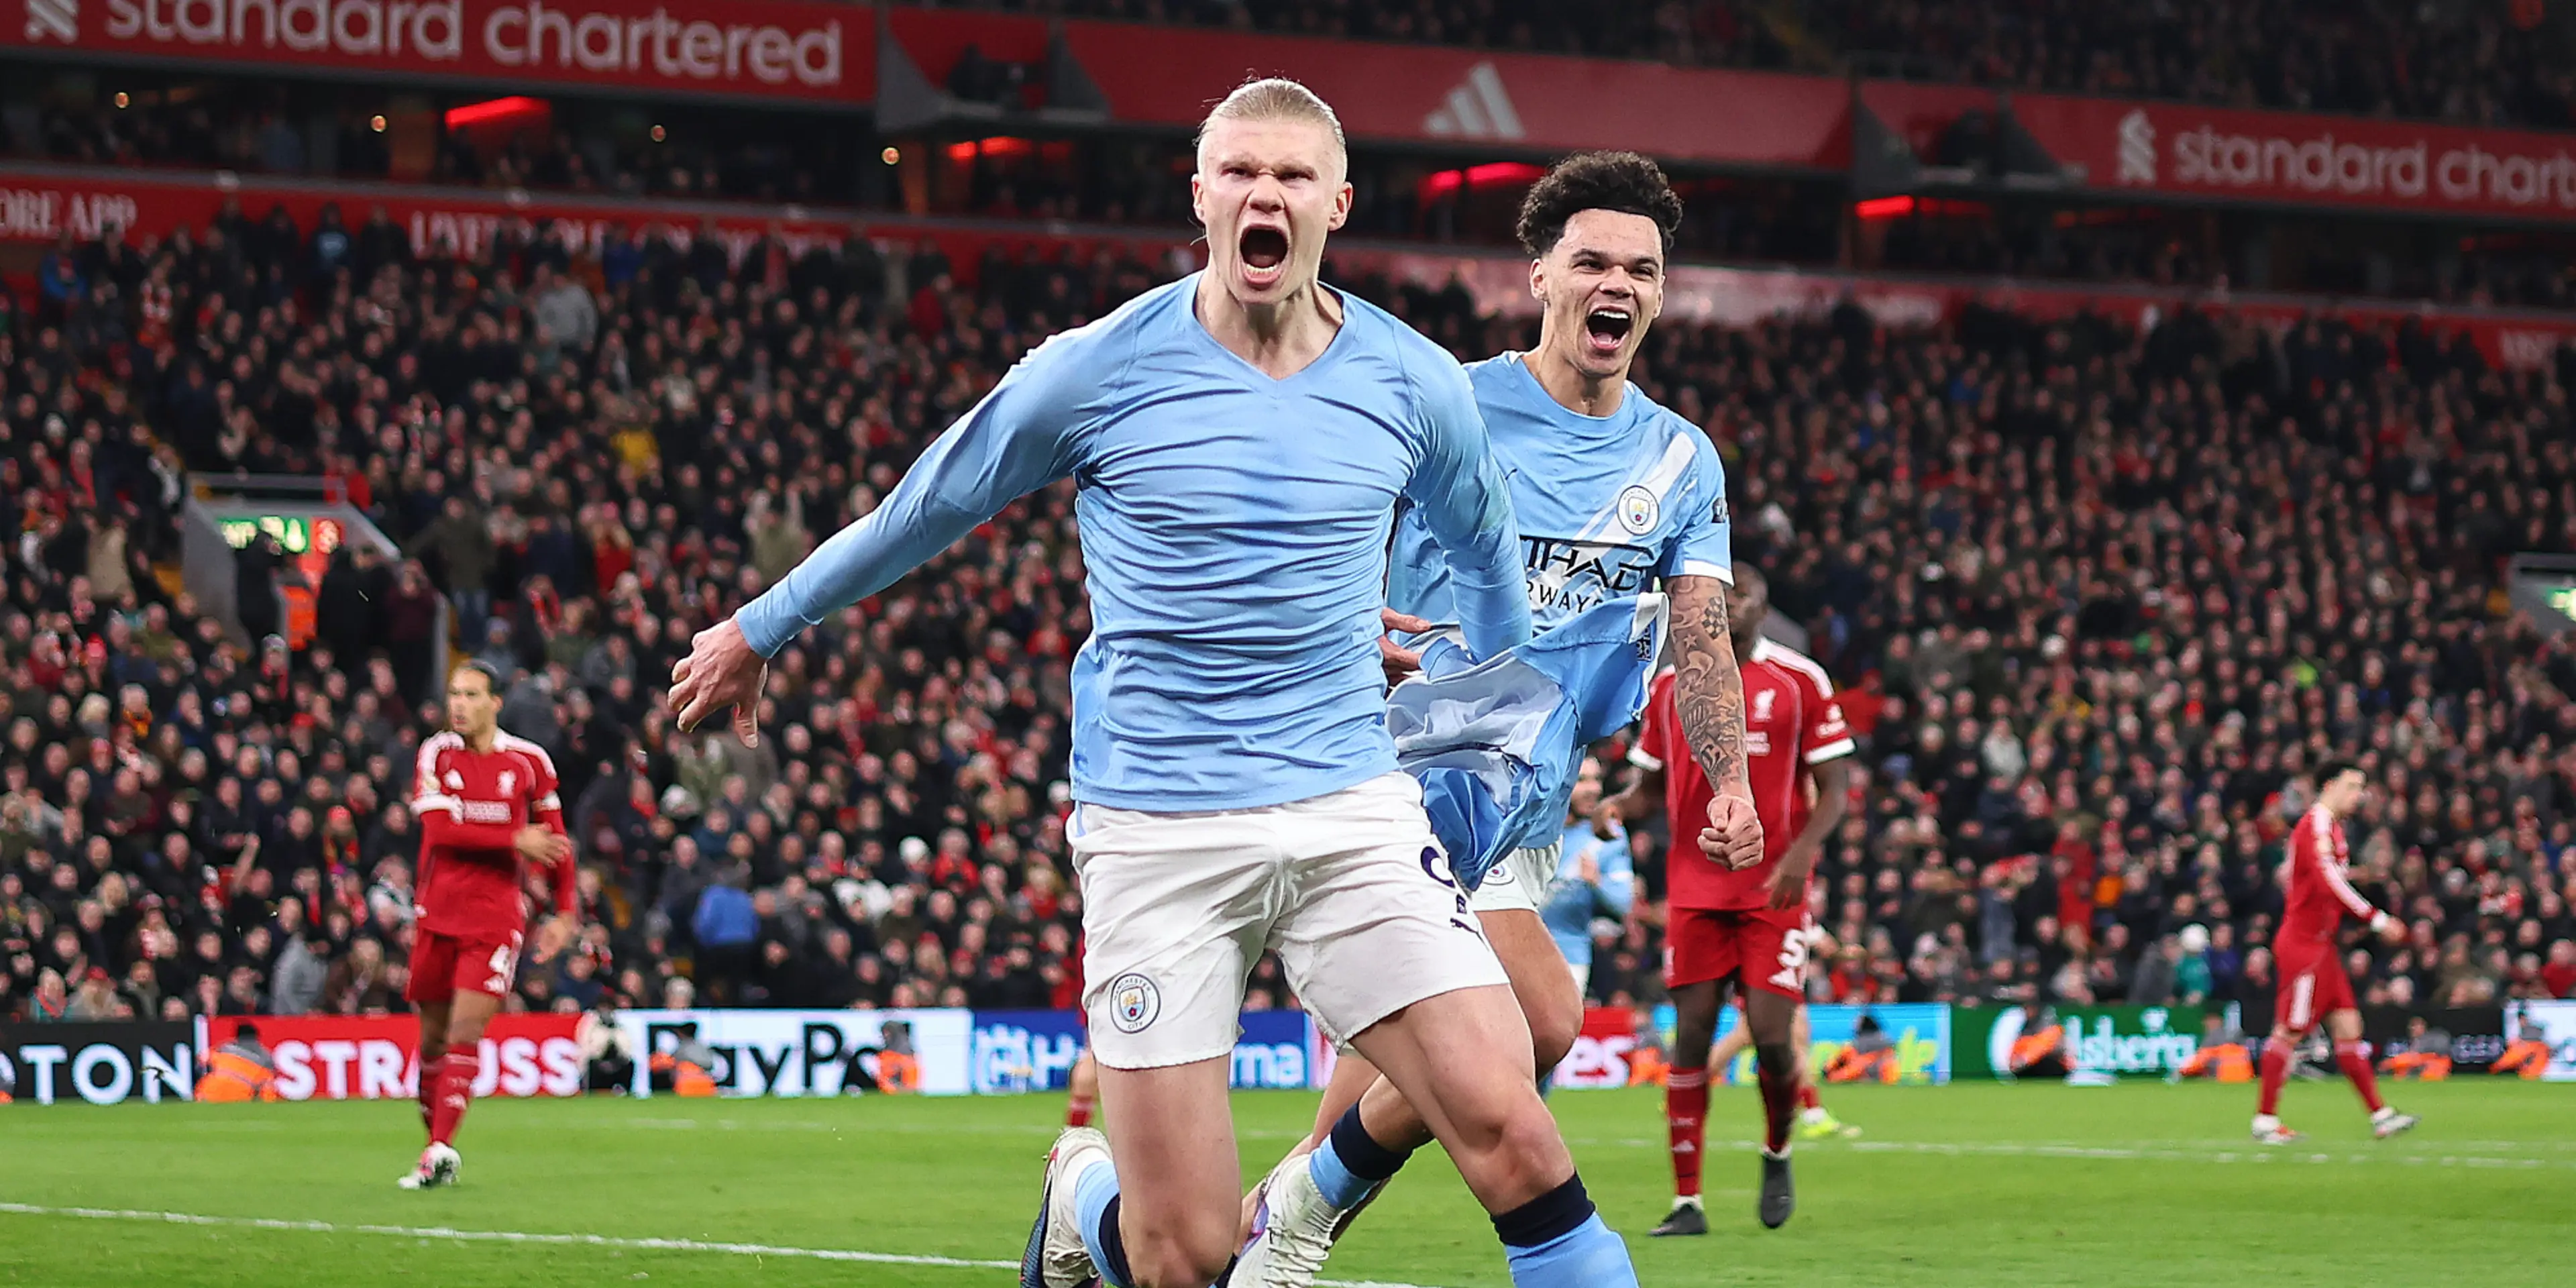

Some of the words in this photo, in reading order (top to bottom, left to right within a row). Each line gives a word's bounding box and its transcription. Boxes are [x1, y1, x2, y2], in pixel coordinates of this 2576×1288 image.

[105, 0, 463, 60] standard
[483, 1, 843, 87] chartered
[2174, 124, 2428, 197] standard
[1776, 928, 1806, 968] 5
[0, 1043, 193, 1104] TON
[272, 1036, 580, 1101] STRUSS
[1987, 1006, 2196, 1084] Clsberg
